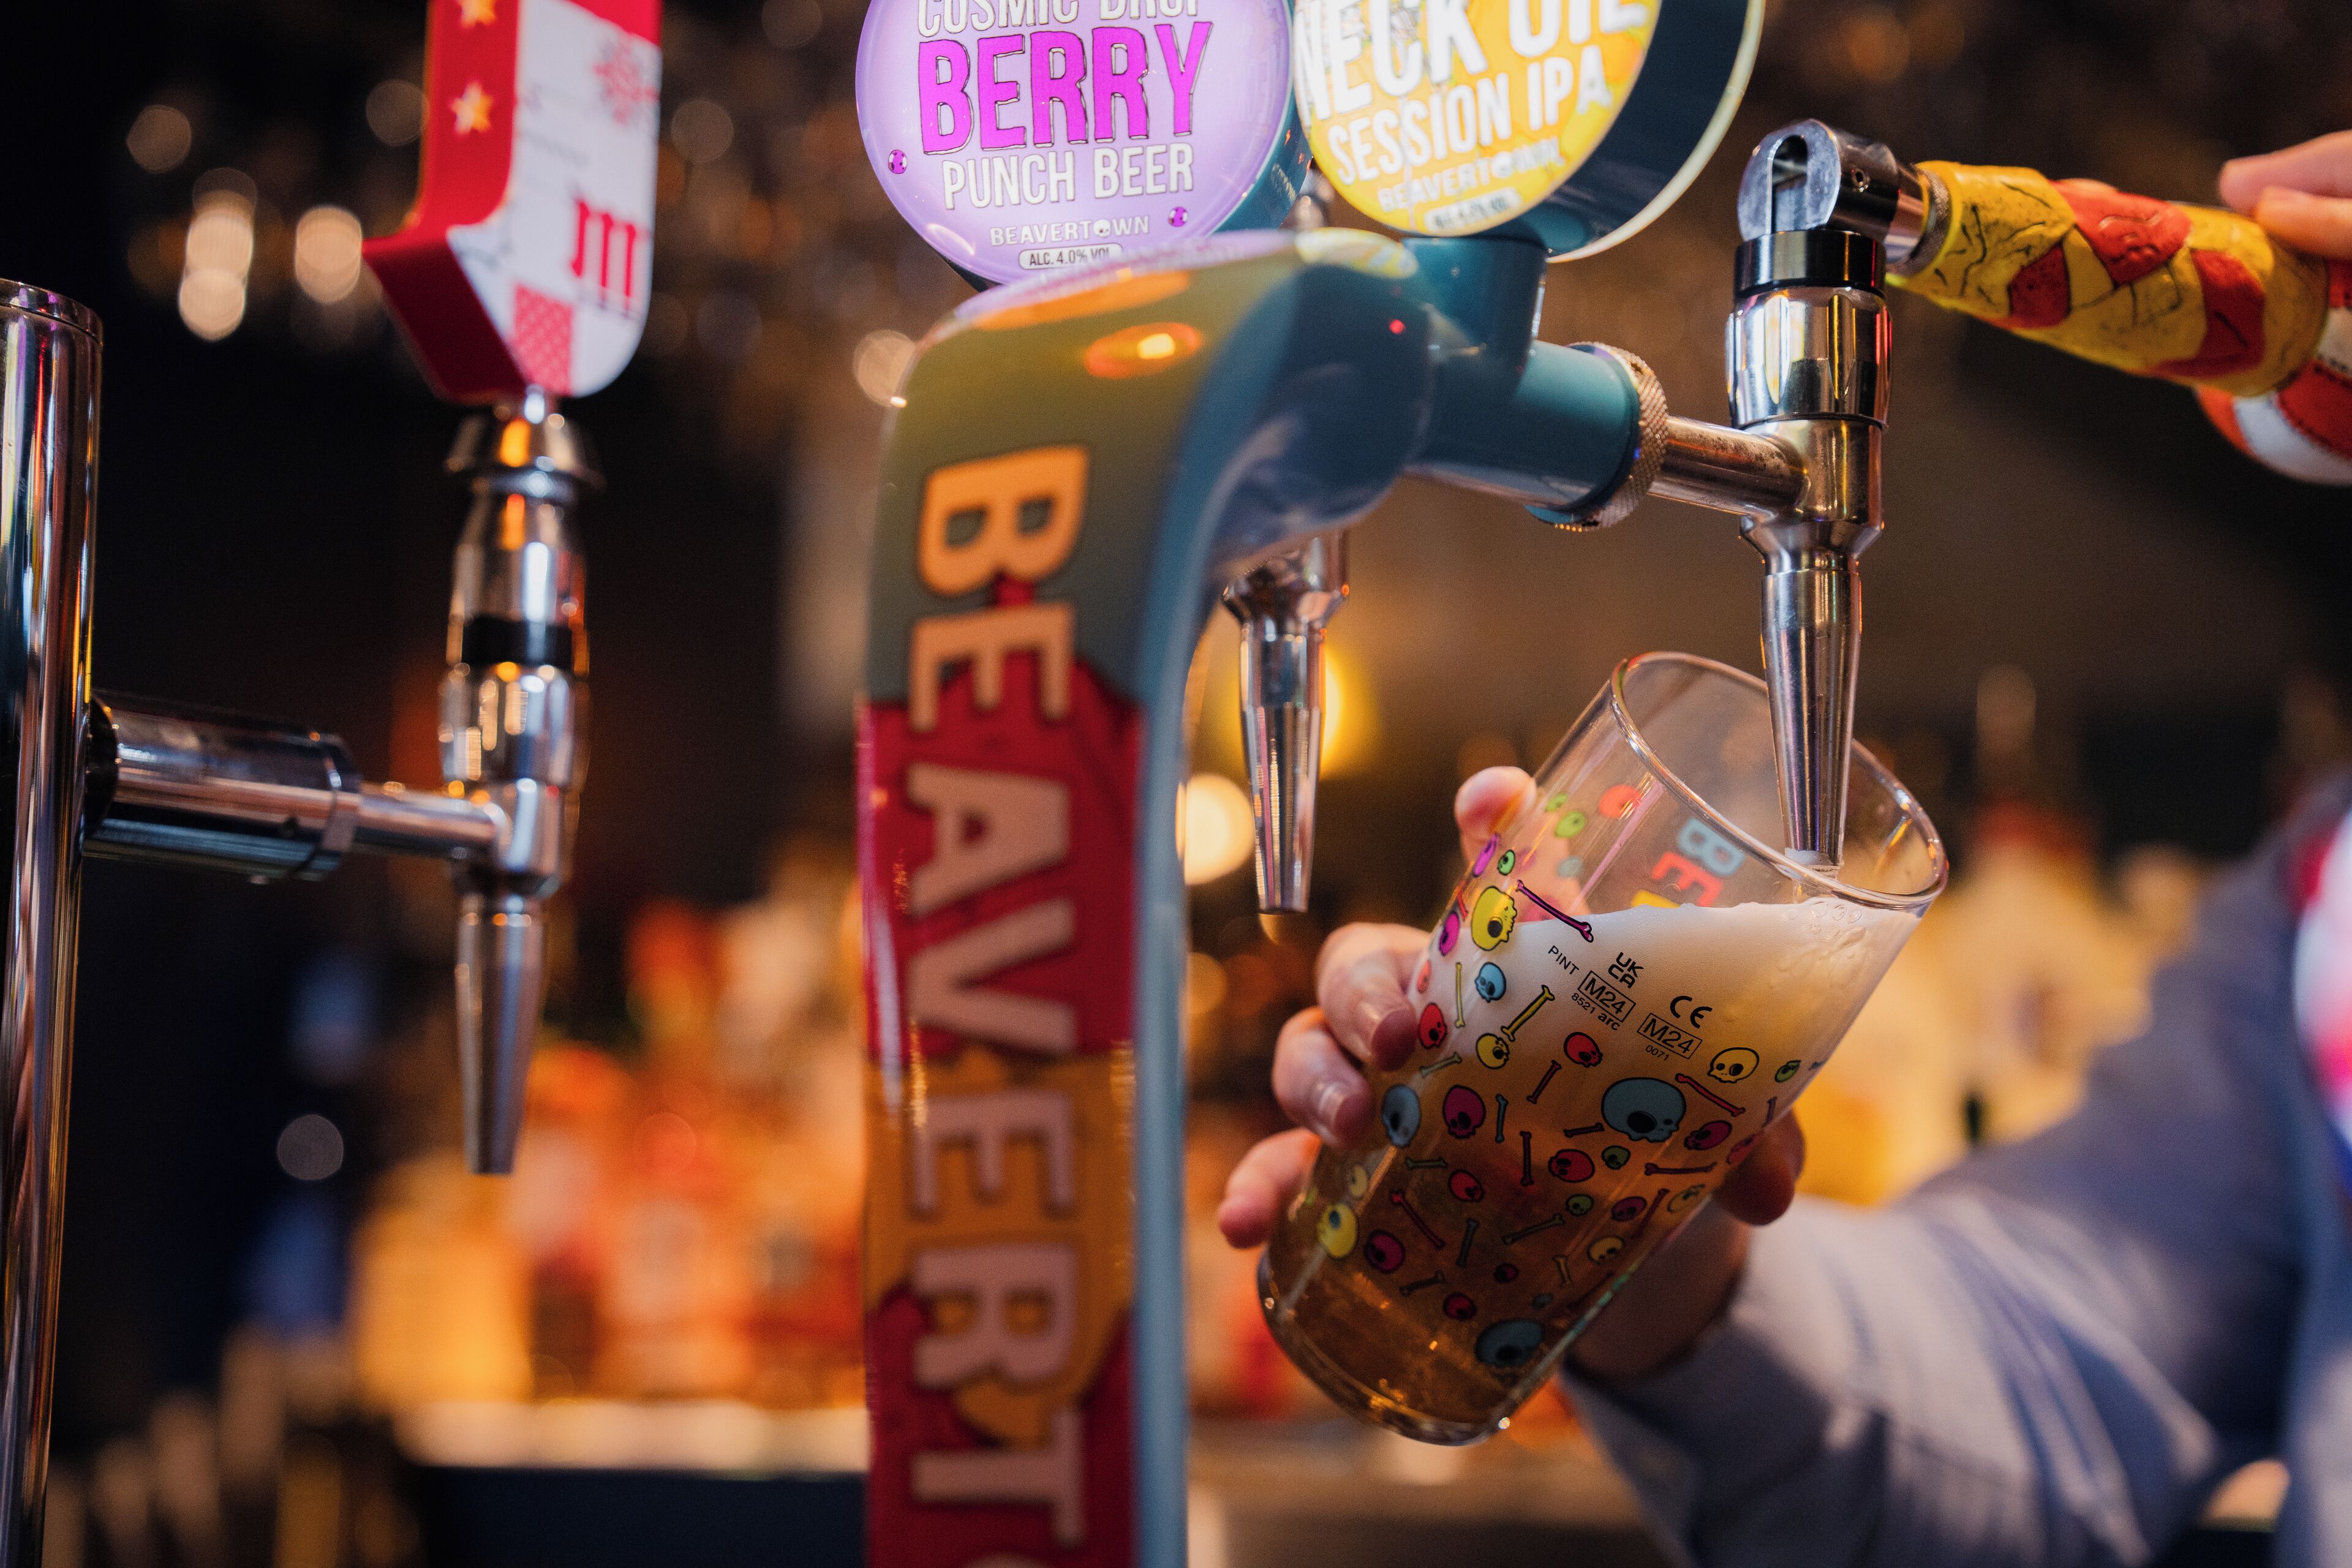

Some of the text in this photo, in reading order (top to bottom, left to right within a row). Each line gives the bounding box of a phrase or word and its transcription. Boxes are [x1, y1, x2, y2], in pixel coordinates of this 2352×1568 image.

[919, 22, 1214, 155] BERRY
[1327, 45, 1612, 185] SESSION IPA
[943, 142, 1194, 210] PUNCH BEER
[1030, 252, 1054, 266] ALC.
[1057, 248, 1088, 264] 4.0%
[1548, 945, 1580, 975] PINT
[1608, 963, 1636, 989] CA
[1616, 952, 1645, 978] UK
[905, 445, 1089, 1568] BEAVERT
[1572, 993, 1620, 1031] 8521 arc
[1584, 977, 1626, 1014] M24
[1670, 995, 1713, 1029] CE
[1643, 1017, 1695, 1054] M24
[1645, 1045, 1670, 1061] 0071
